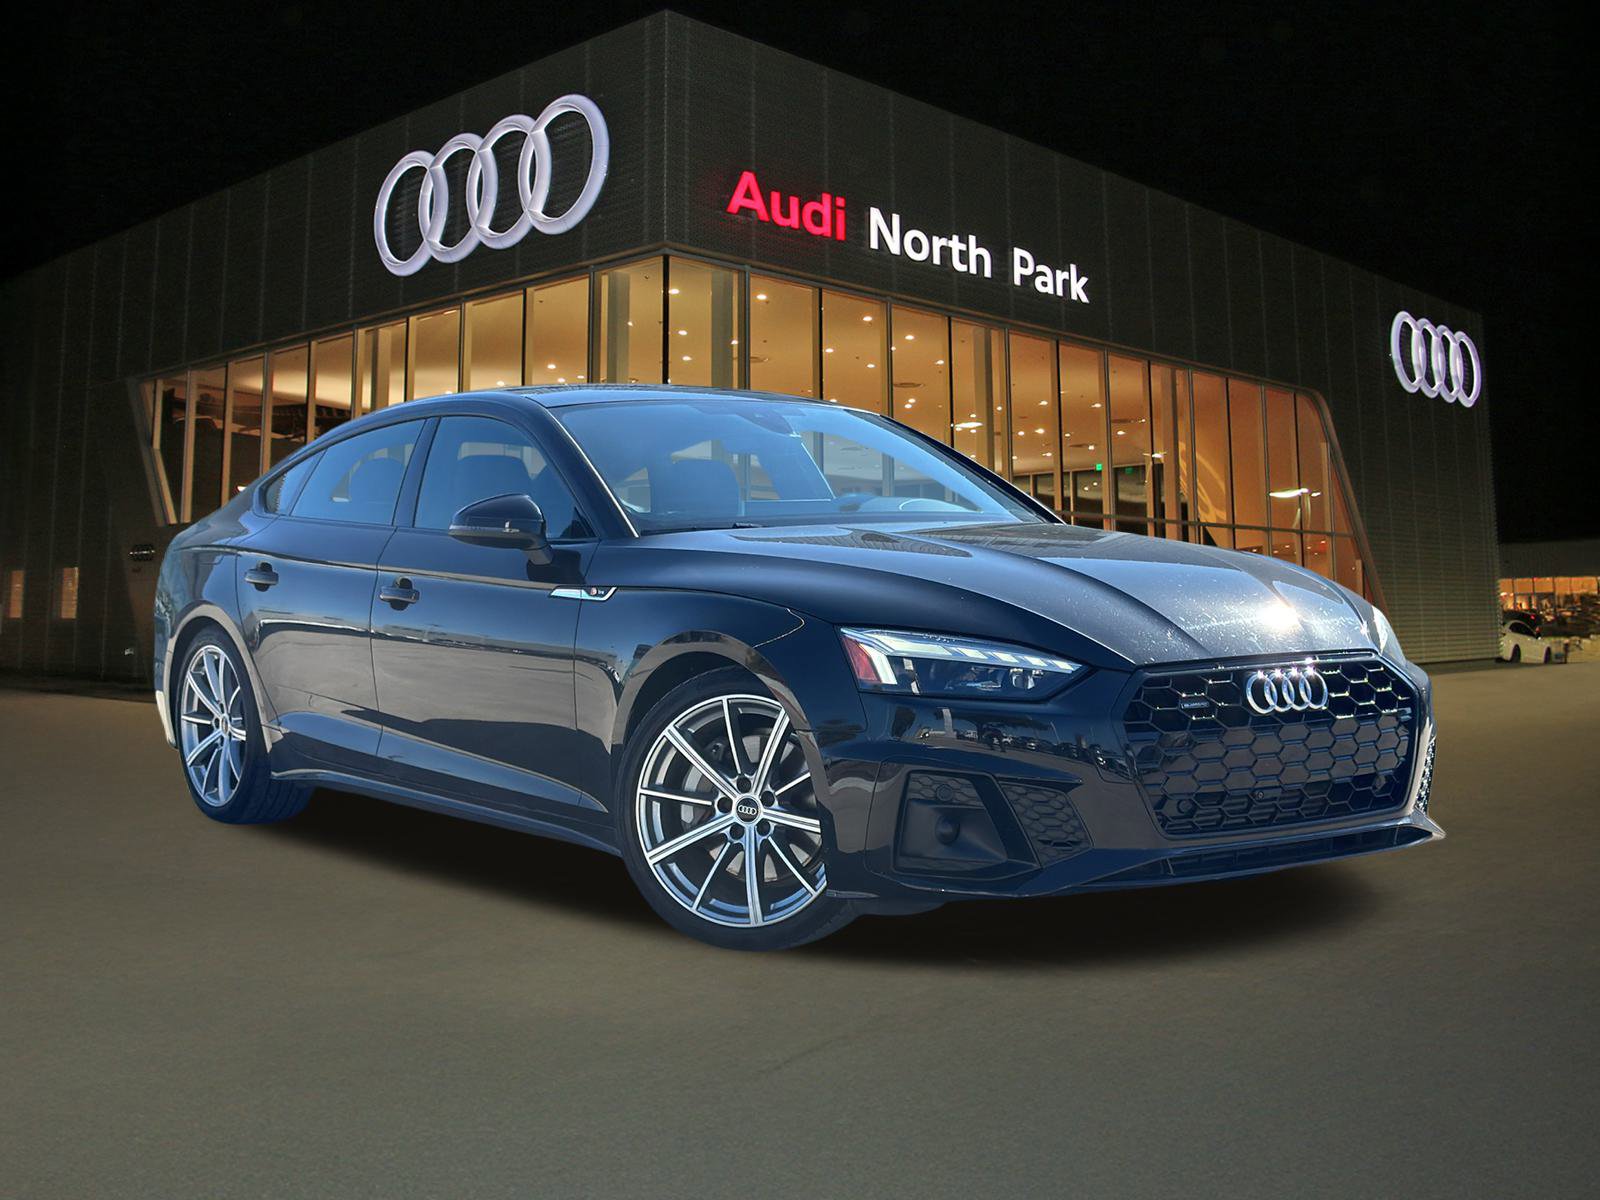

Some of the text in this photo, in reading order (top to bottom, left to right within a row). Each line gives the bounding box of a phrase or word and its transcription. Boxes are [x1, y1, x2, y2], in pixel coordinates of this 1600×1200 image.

[726, 171, 1090, 304] Audi North Park
